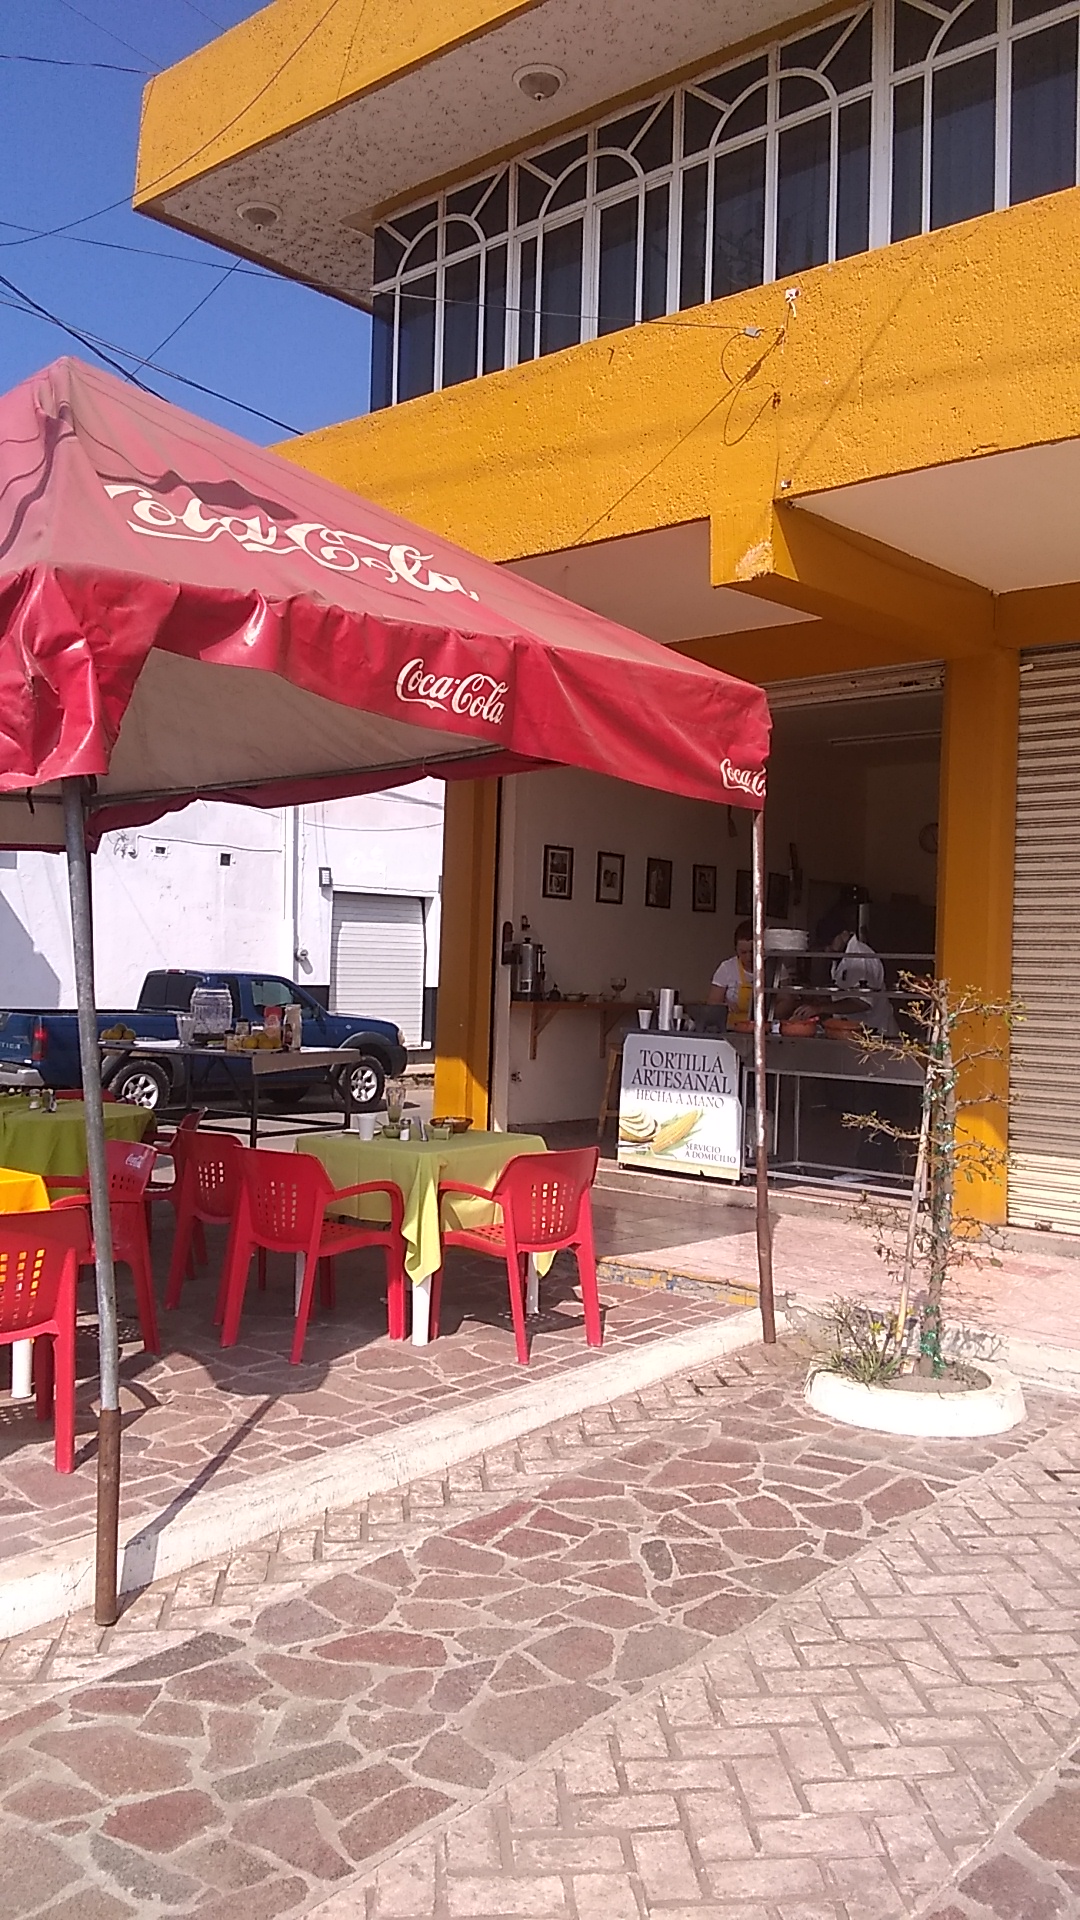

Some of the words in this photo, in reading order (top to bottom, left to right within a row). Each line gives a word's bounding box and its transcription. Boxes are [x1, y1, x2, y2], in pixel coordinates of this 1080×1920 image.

[395, 657, 510, 725] Coca-Cola
[639, 1049, 724, 1074] TORTILLA
[631, 1067, 732, 1095] ARTESANAL
[636, 1088, 673, 1104] HECHA
[675, 1093, 684, 1105] A
[686, 1094, 725, 1109] MANO
[684, 1150, 691, 1158] A
[691, 1151, 737, 1164] DOMICILIO
[685, 1142, 721, 1154] SERVICIO
